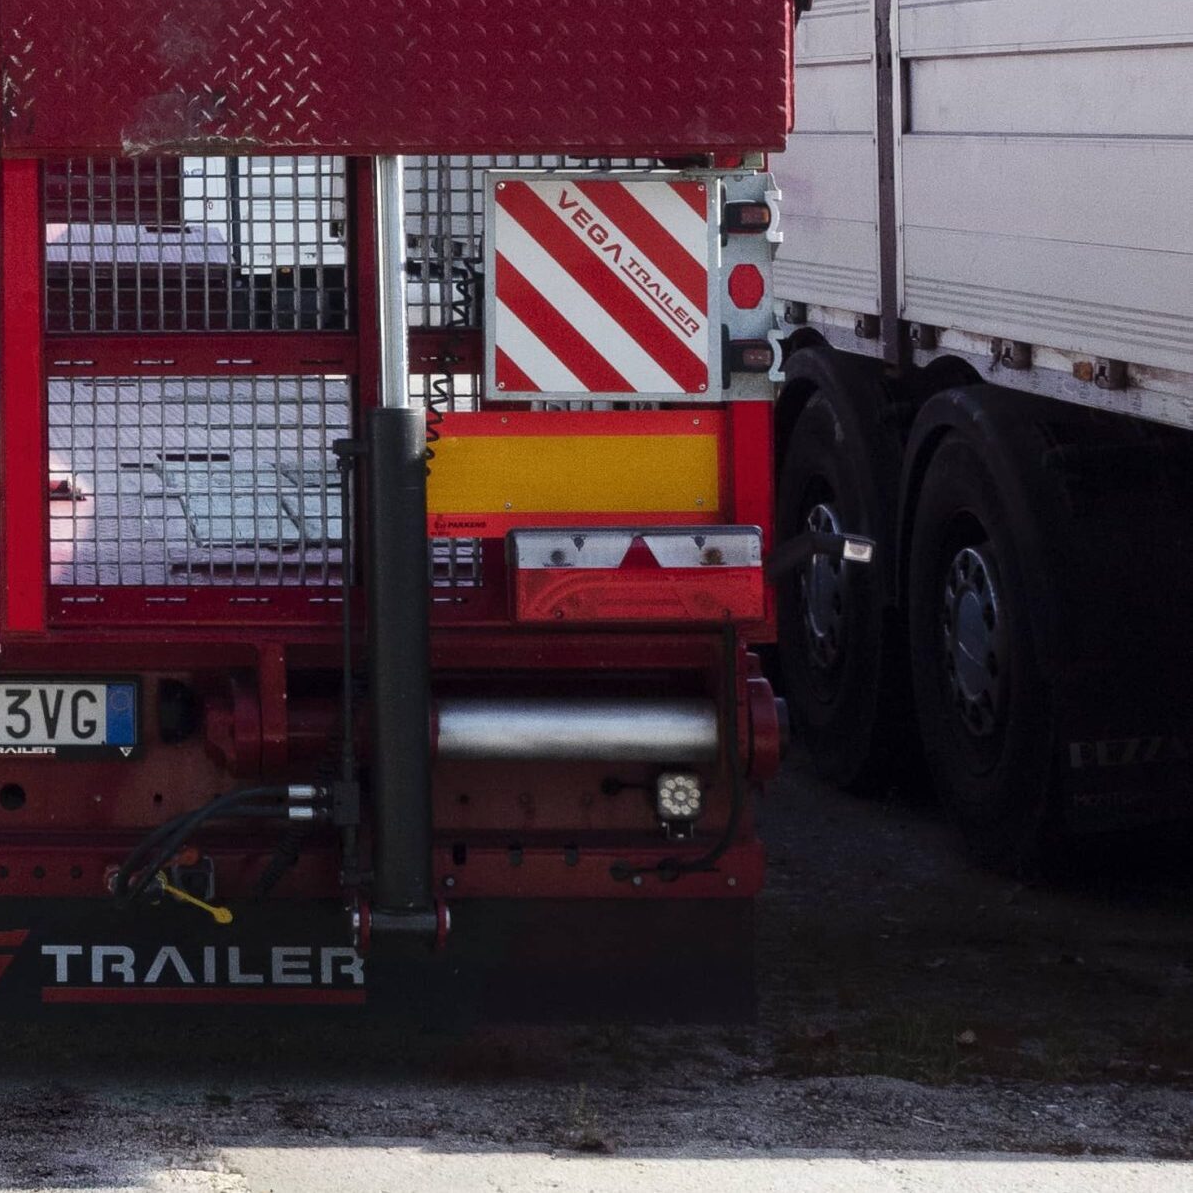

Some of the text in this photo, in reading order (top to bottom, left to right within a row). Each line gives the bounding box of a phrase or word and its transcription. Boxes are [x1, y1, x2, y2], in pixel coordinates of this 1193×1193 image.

[558, 190, 700, 334] VEGA TRAILER
[41, 944, 366, 985] TRAILER
